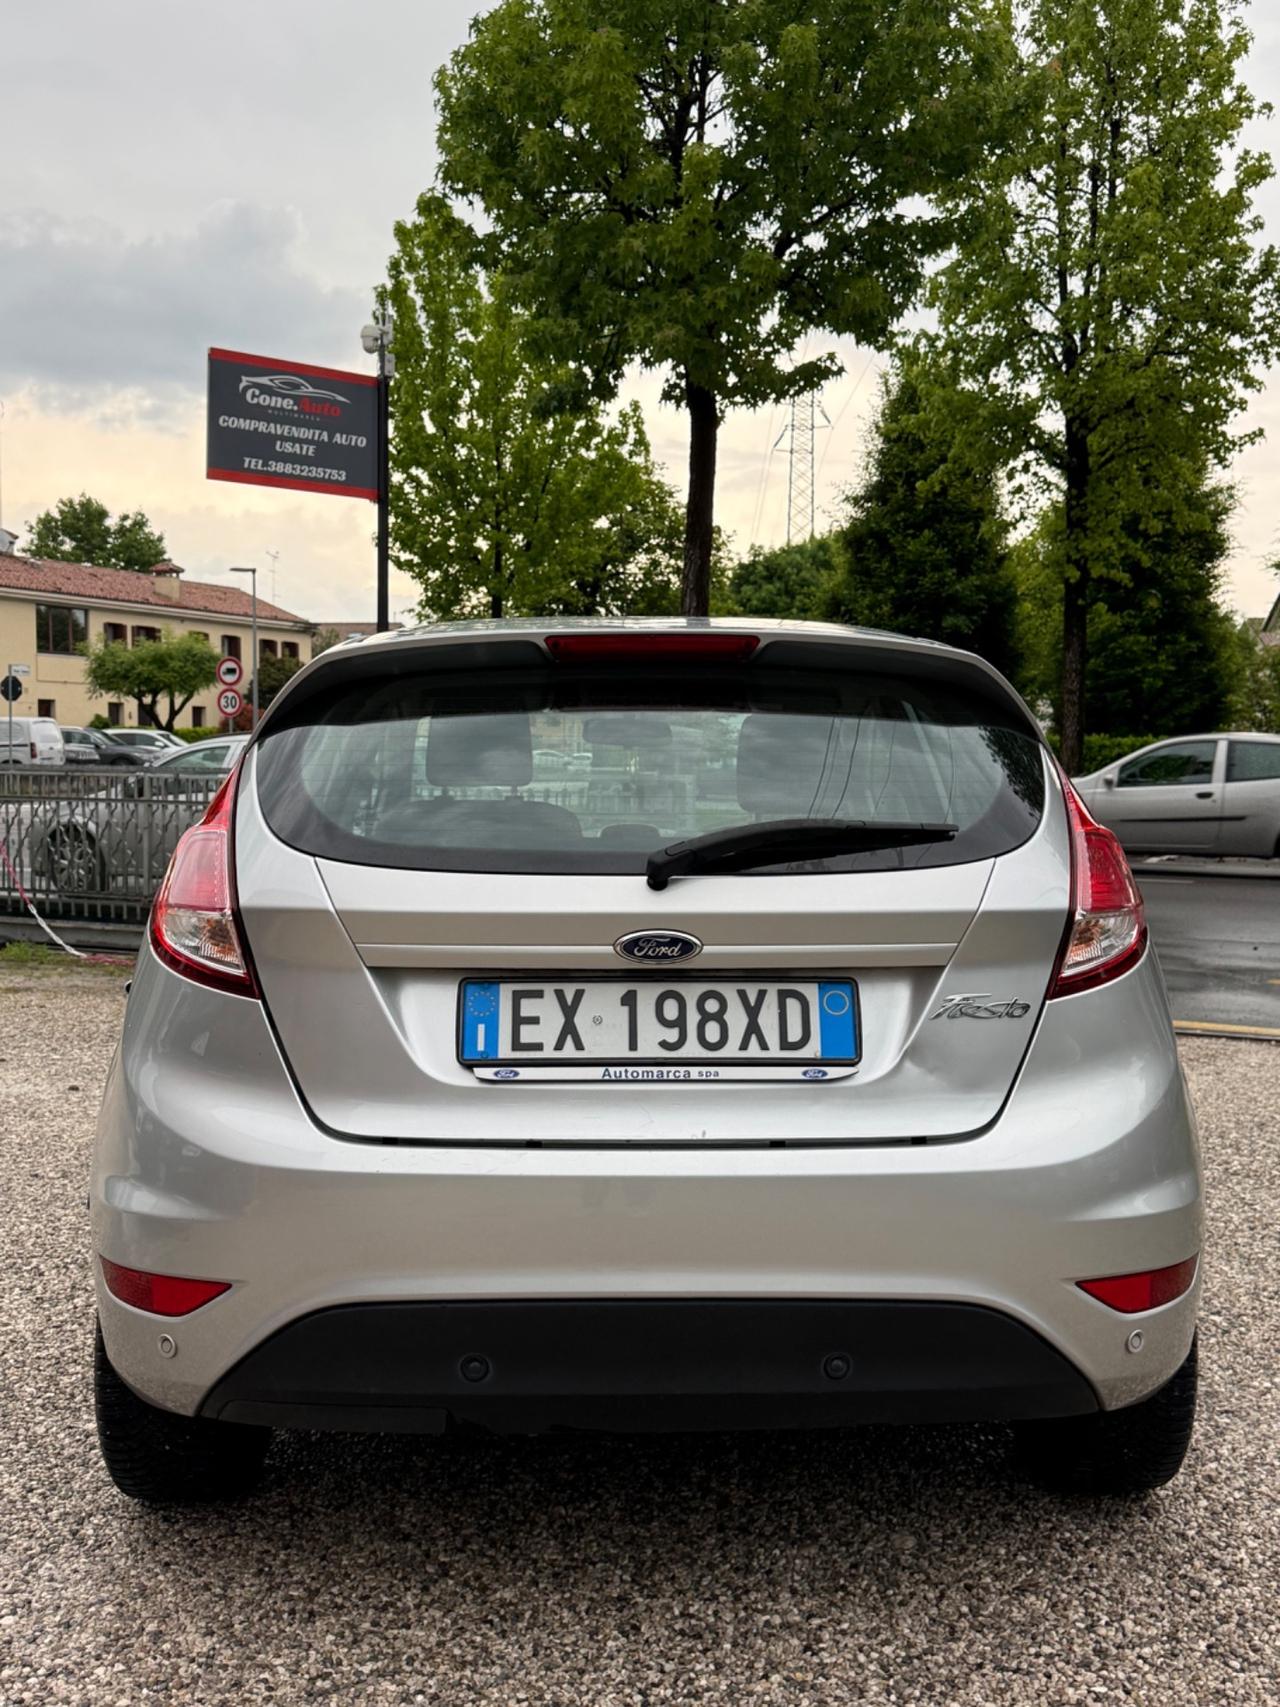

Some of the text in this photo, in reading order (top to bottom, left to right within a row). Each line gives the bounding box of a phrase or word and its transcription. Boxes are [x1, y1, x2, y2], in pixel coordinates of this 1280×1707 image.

[218, 415, 367, 448] COMPRAVENDITA AUTO
[275, 440, 317, 457] USATE
[243, 457, 346, 481] TEL.3883235753
[223, 695, 237, 709] 30
[633, 937, 682, 957] Ford
[511, 988, 586, 1052] EX
[620, 988, 811, 1052] 198XD
[602, 1067, 691, 1079] Automarca
[697, 1069, 719, 1078] spa
